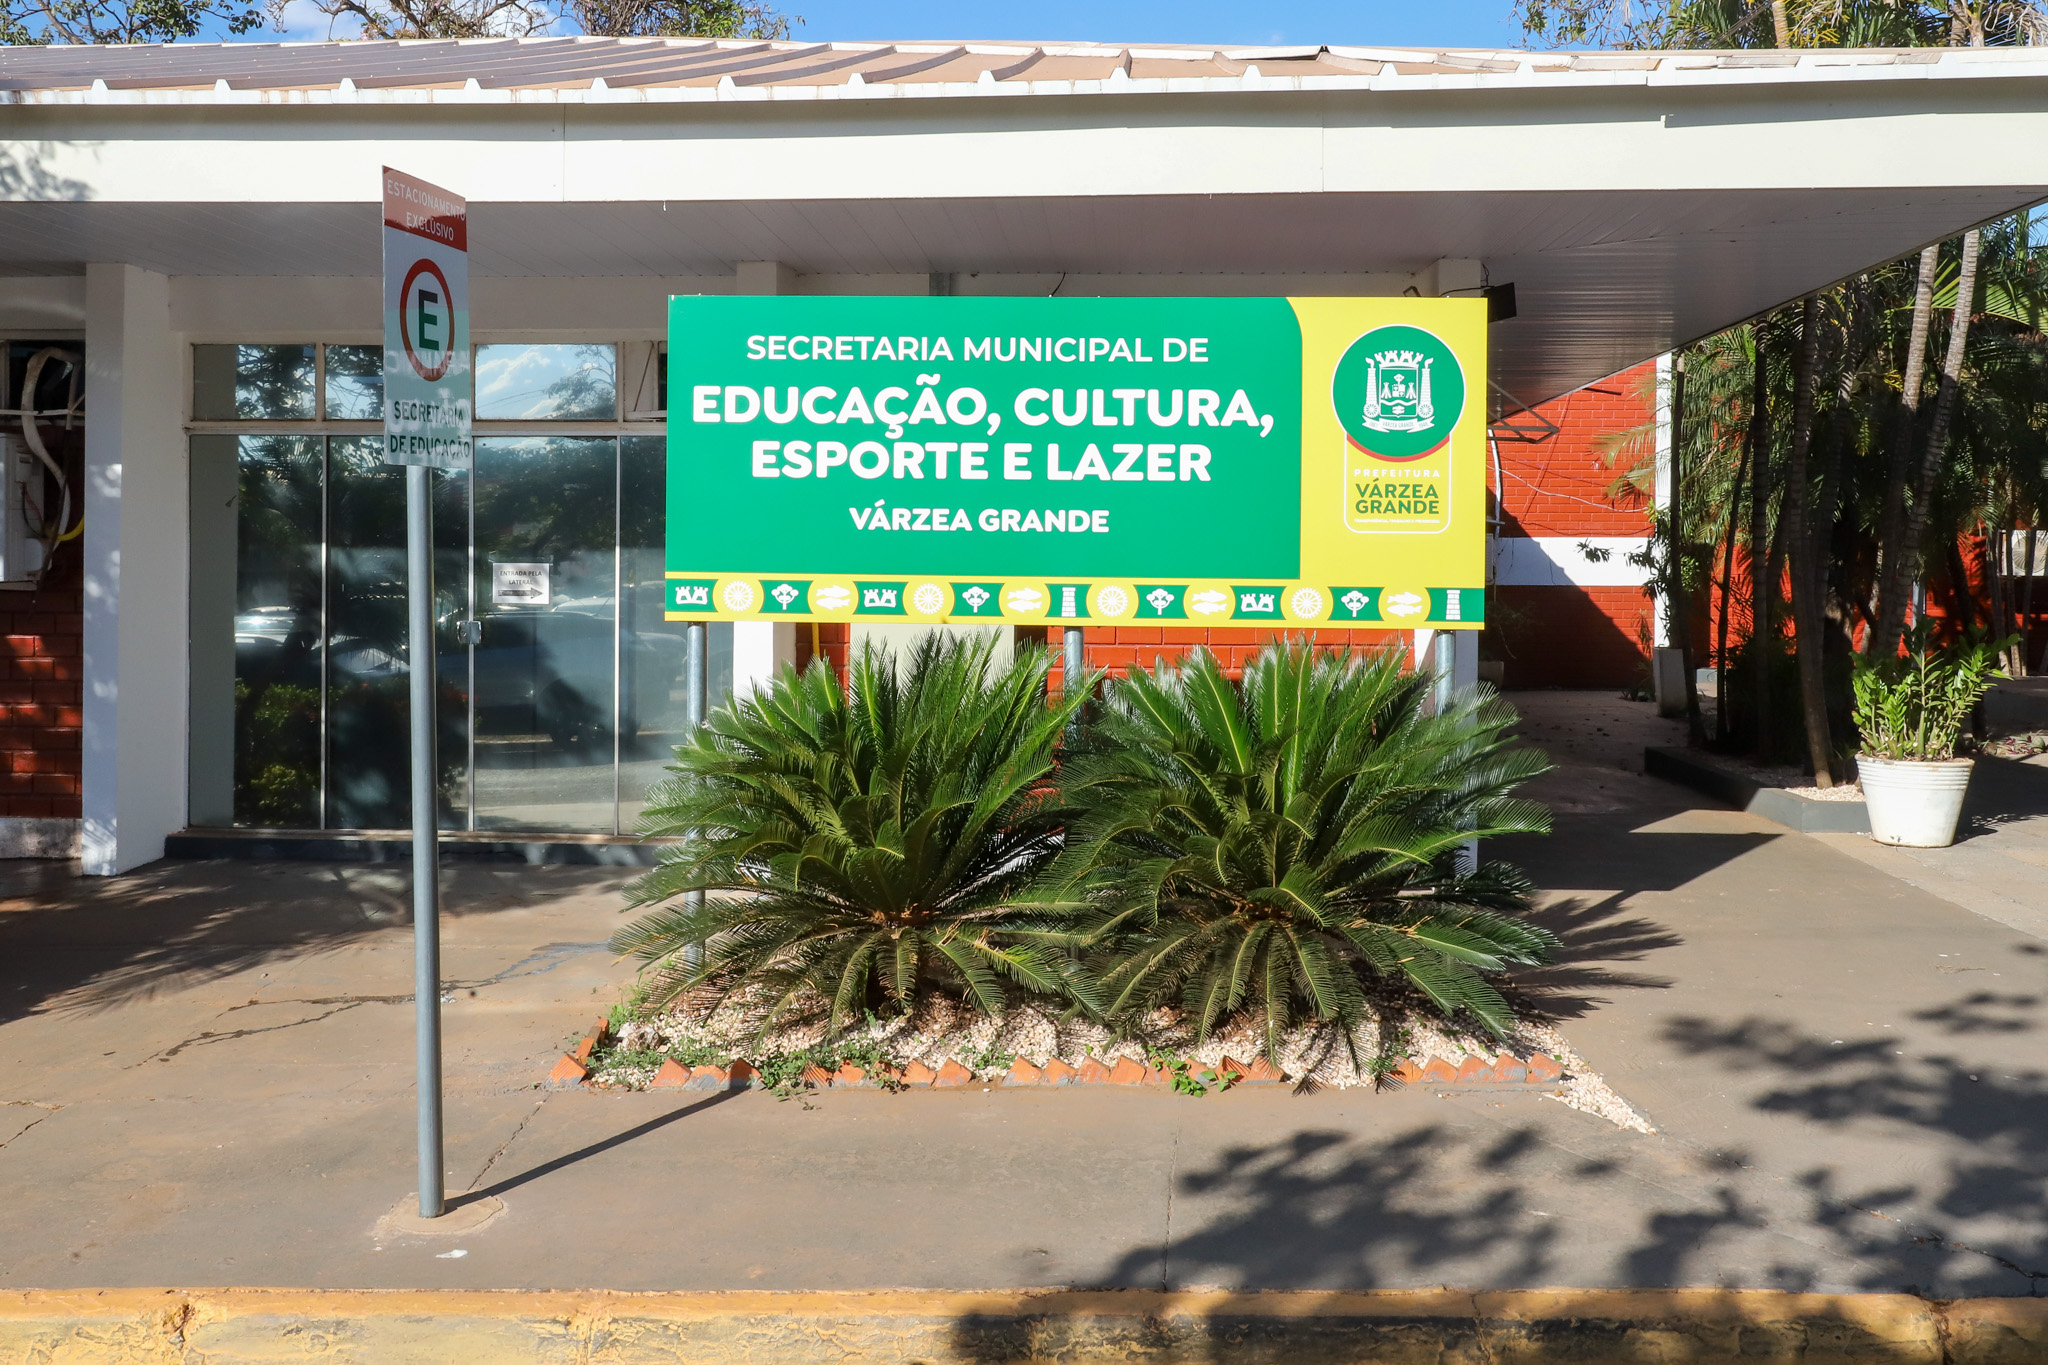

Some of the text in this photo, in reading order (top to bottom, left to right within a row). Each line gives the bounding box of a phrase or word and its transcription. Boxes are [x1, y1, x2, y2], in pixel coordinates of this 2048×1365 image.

[387, 179, 465, 221] ESTACIONAMENTO
[406, 212, 454, 241] EXCLUSIVO
[418, 288, 440, 351] E
[745, 335, 1209, 363] SECRETARIA MUNICIPAL DE
[394, 401, 464, 426] SECRETARIA
[692, 373, 1275, 439] EDUCAÇÃO, CULTURA,
[390, 435, 470, 460] DE EDUCAÇÃO
[751, 440, 1212, 482] ESPORTE E LAZER
[1354, 469, 1440, 477] PREFEITURA
[1355, 478, 1438, 498] VÁRZEA
[849, 499, 1110, 533] VÁRZEA GRANDE
[1355, 500, 1440, 514] GRANDE
